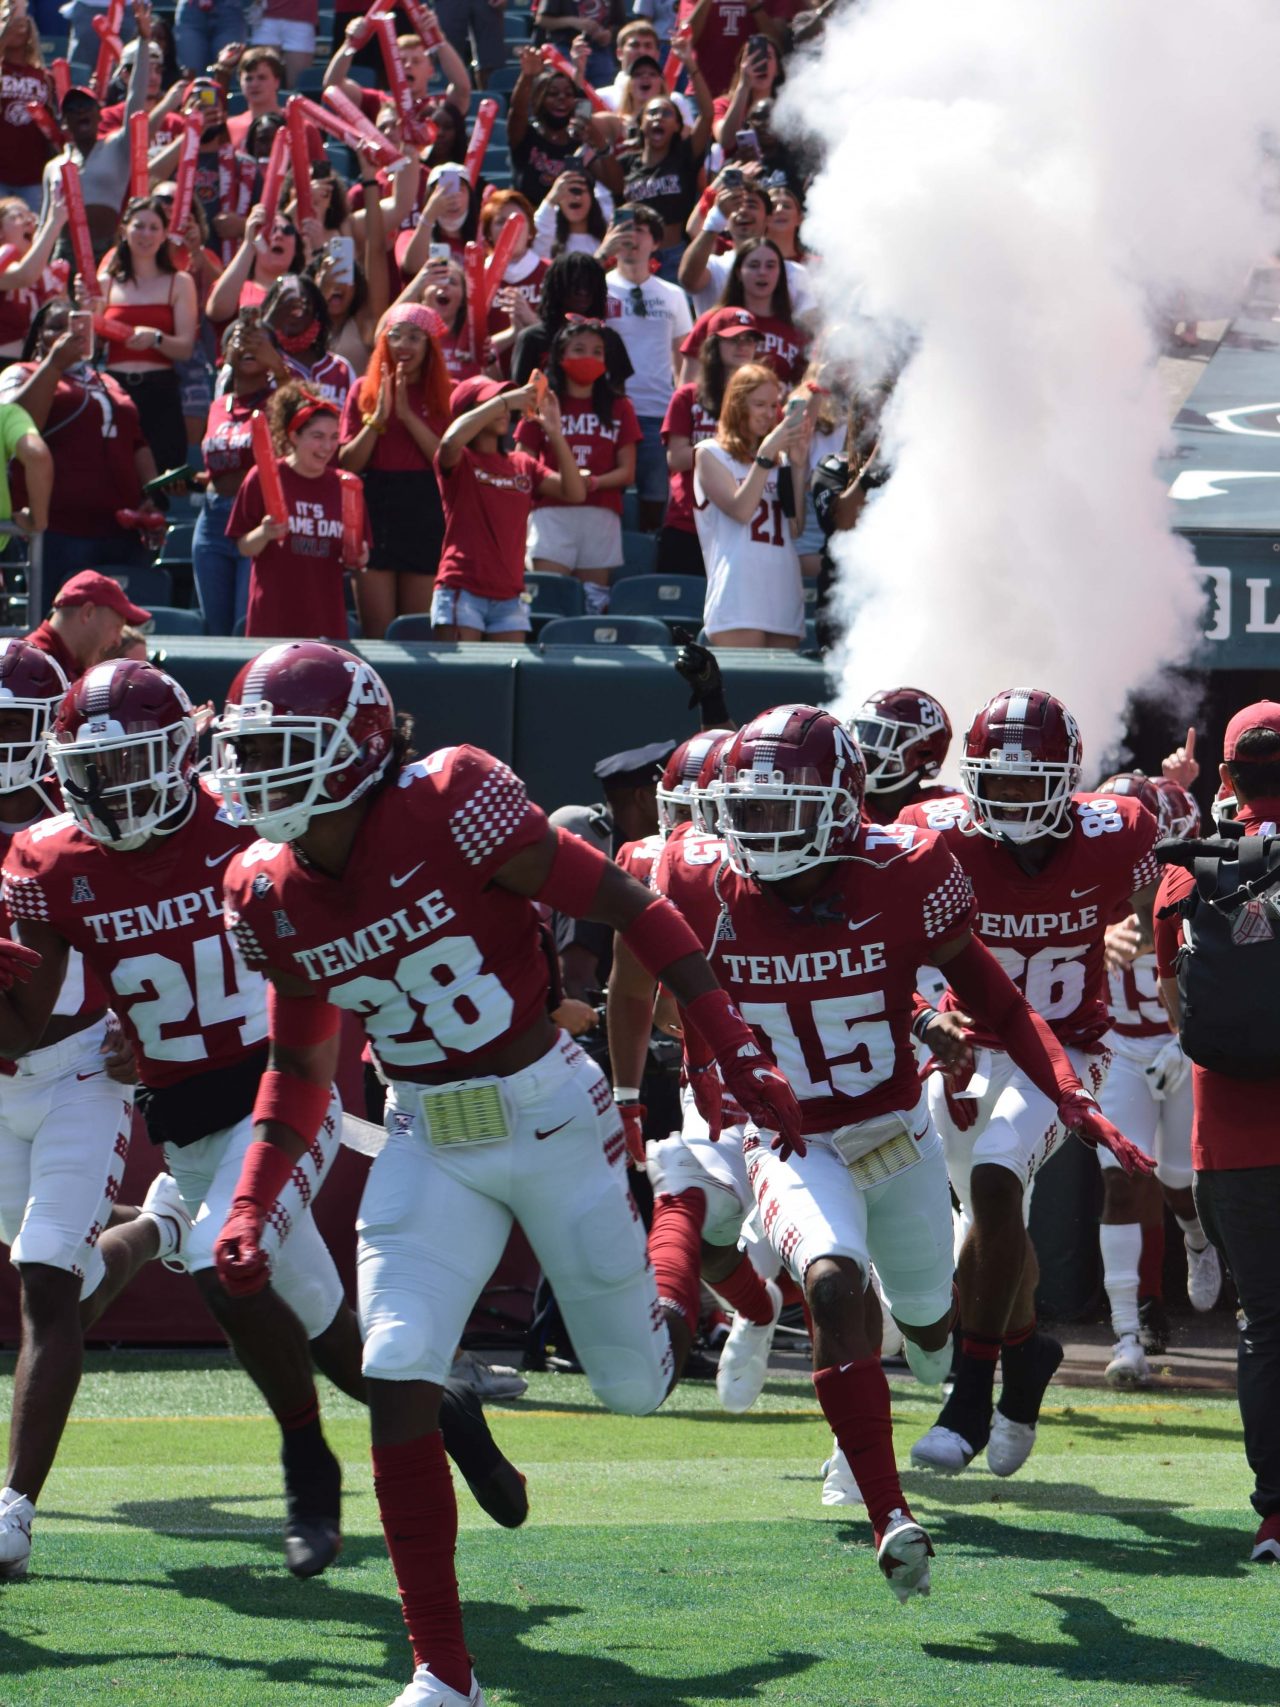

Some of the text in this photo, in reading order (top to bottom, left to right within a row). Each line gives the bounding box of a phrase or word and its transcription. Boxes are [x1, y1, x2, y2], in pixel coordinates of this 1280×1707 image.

[719, 6, 746, 35] T
[296, 500, 325, 519] IT'S
[317, 519, 344, 539] DAY
[751, 498, 784, 547] 21
[754, 773, 769, 784] 215
[1005, 753, 1019, 763] 215
[83, 887, 227, 945] TEMPL
[293, 890, 457, 981] TEMPLE
[722, 942, 886, 985] TEMPLE
[111, 934, 270, 1063] 24
[328, 935, 515, 1067] 28
[738, 991, 896, 1098] 15
